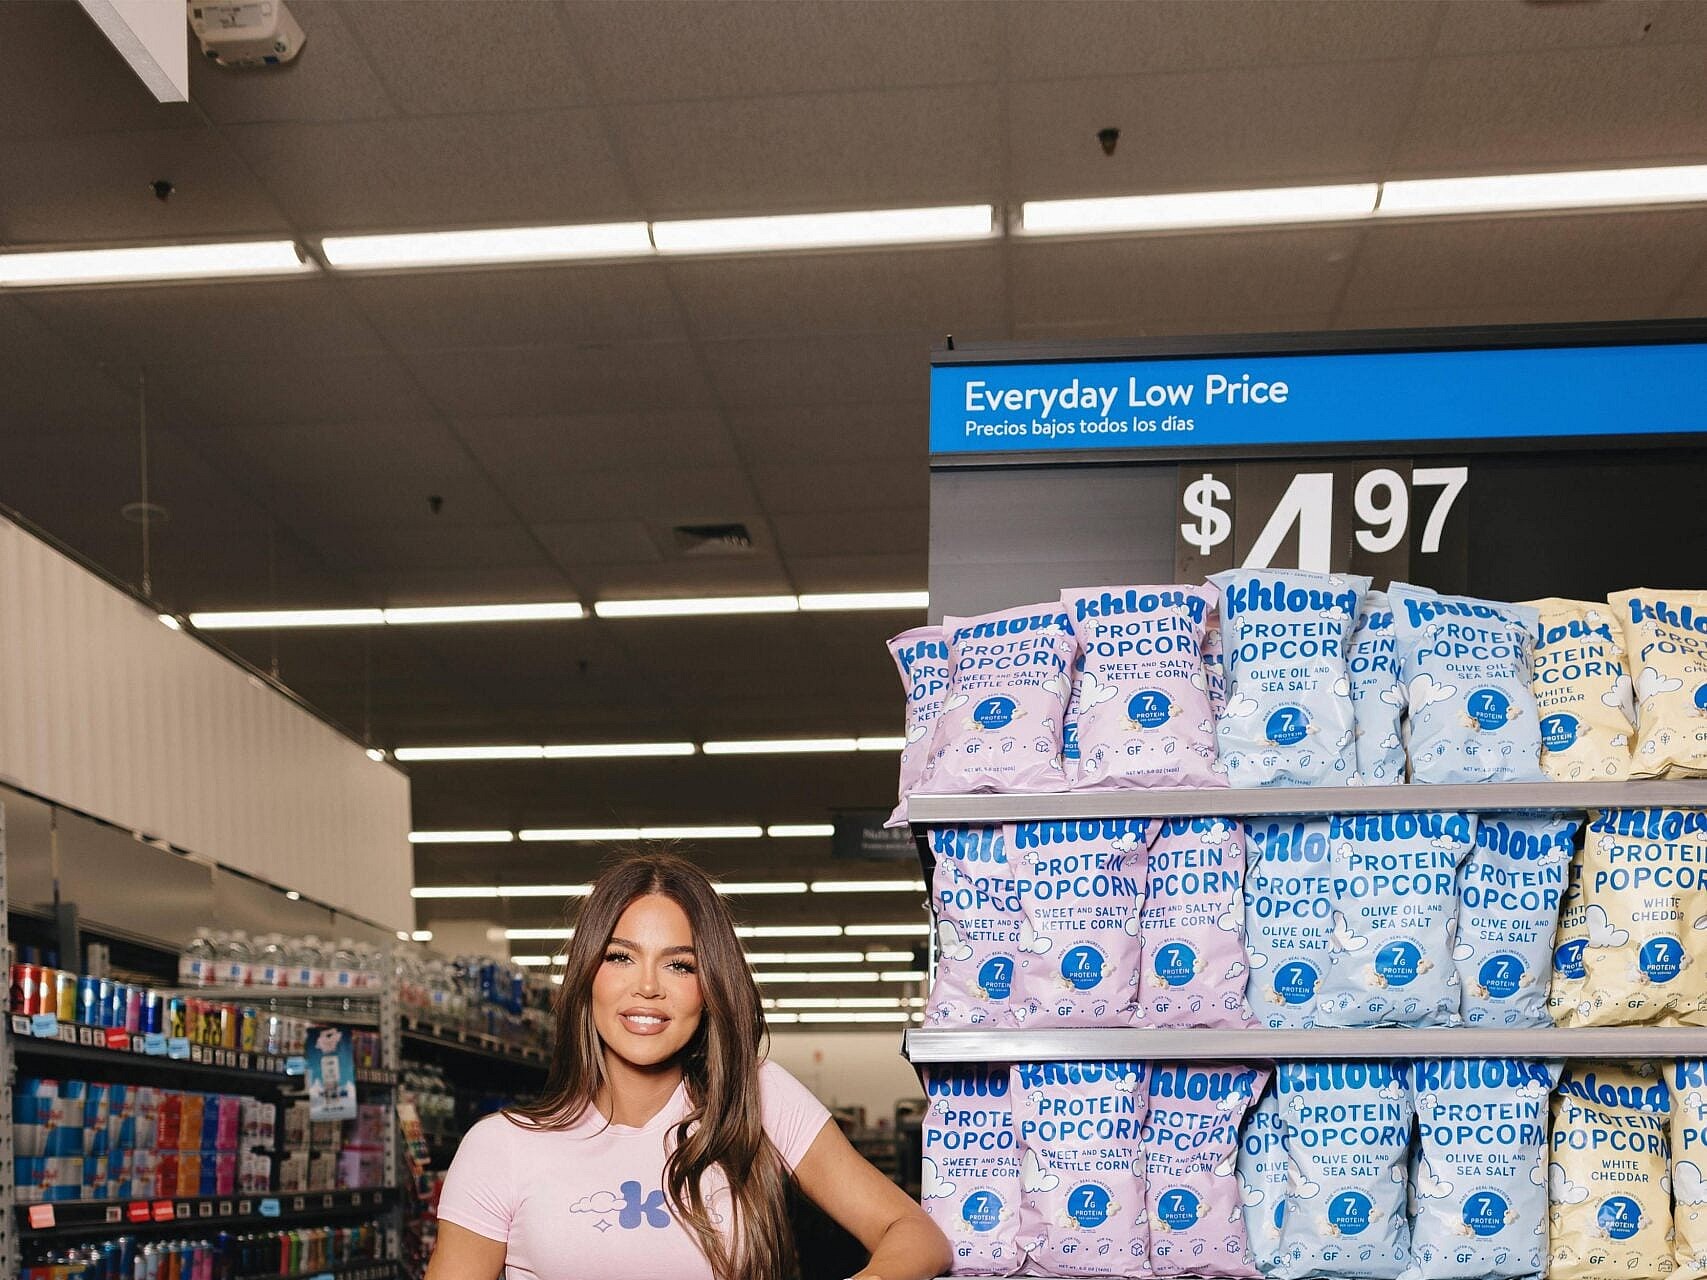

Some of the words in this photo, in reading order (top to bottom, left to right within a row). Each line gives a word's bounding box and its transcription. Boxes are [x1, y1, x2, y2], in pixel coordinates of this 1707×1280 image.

[965, 378, 1118, 418] Everyday
[1129, 377, 1194, 408] Low
[1205, 374, 1289, 405] Price
[965, 419, 1027, 436] Precios
[1031, 418, 1075, 439] bajos
[1080, 417, 1128, 434] todos
[1132, 416, 1157, 433] los
[1161, 416, 1194, 432] días
[1226, 579, 1356, 619] khloud
[1095, 617, 1193, 638] PROTEIN
[1239, 622, 1342, 640] PROTEIN
[960, 637, 1054, 656] PROTEIN
[1100, 662, 1138, 673] SWEET
[1159, 660, 1194, 670] SALTY
[1251, 669, 1285, 680] OLIVE
[1291, 668, 1311, 678] OIL
[1314, 666, 1330, 674] AND
[1107, 670, 1150, 681] KETTLE
[1153, 669, 1189, 680] CORN
[1261, 681, 1284, 692] SEA
[1289, 681, 1318, 691] SALT
[1136, 710, 1165, 719] PROTEIN
[1127, 745, 1142, 756] GF
[1034, 853, 1124, 877] PROTEIN
[1349, 852, 1456, 871] PROTEIN
[1464, 863, 1562, 889] PROTEIN
[1017, 875, 1138, 900] POPCORN
[1643, 897, 1681, 909] WHITE
[1034, 907, 1073, 919] SWEET
[1095, 906, 1128, 917] SALTY
[1361, 906, 1398, 917] OLIVE
[1403, 904, 1424, 915] OIL
[1042, 919, 1087, 931] KETTLE
[1090, 917, 1122, 929] CORN
[1371, 917, 1396, 929] SEA
[1401, 917, 1432, 928] SALT
[1069, 971, 1098, 979] PROTEIN
[1058, 1006, 1073, 1016] GF
[1038, 1096, 1136, 1117] PROTEIN
[1300, 1103, 1400, 1124] PROTEIN
[1432, 1102, 1540, 1122] PROTEIN
[1569, 1106, 1662, 1132] PROTEIN
[1021, 1119, 1143, 1142] POPCORN
[1287, 1125, 1411, 1148] POPCORN
[1418, 1123, 1549, 1146] POPCORN
[1554, 1129, 1671, 1159] POPCORN
[1041, 1148, 1078, 1160] SWEET
[1100, 1148, 1133, 1158] SALTY
[1445, 1153, 1483, 1164] OLIVE
[1488, 1153, 1509, 1164] OIL
[1512, 1153, 1526, 1161] AND
[1049, 1160, 1091, 1171] KETTLE
[1096, 1159, 1129, 1170] CORN
[1457, 1165, 1481, 1176] SEA
[1486, 1165, 1517, 1177] SALT
[1602, 1159, 1639, 1171] WHITE
[1591, 1171, 1649, 1183] CHEDDAR
[1471, 1217, 1499, 1225] PROTEIN
[1456, 1253, 1472, 1263] GF
